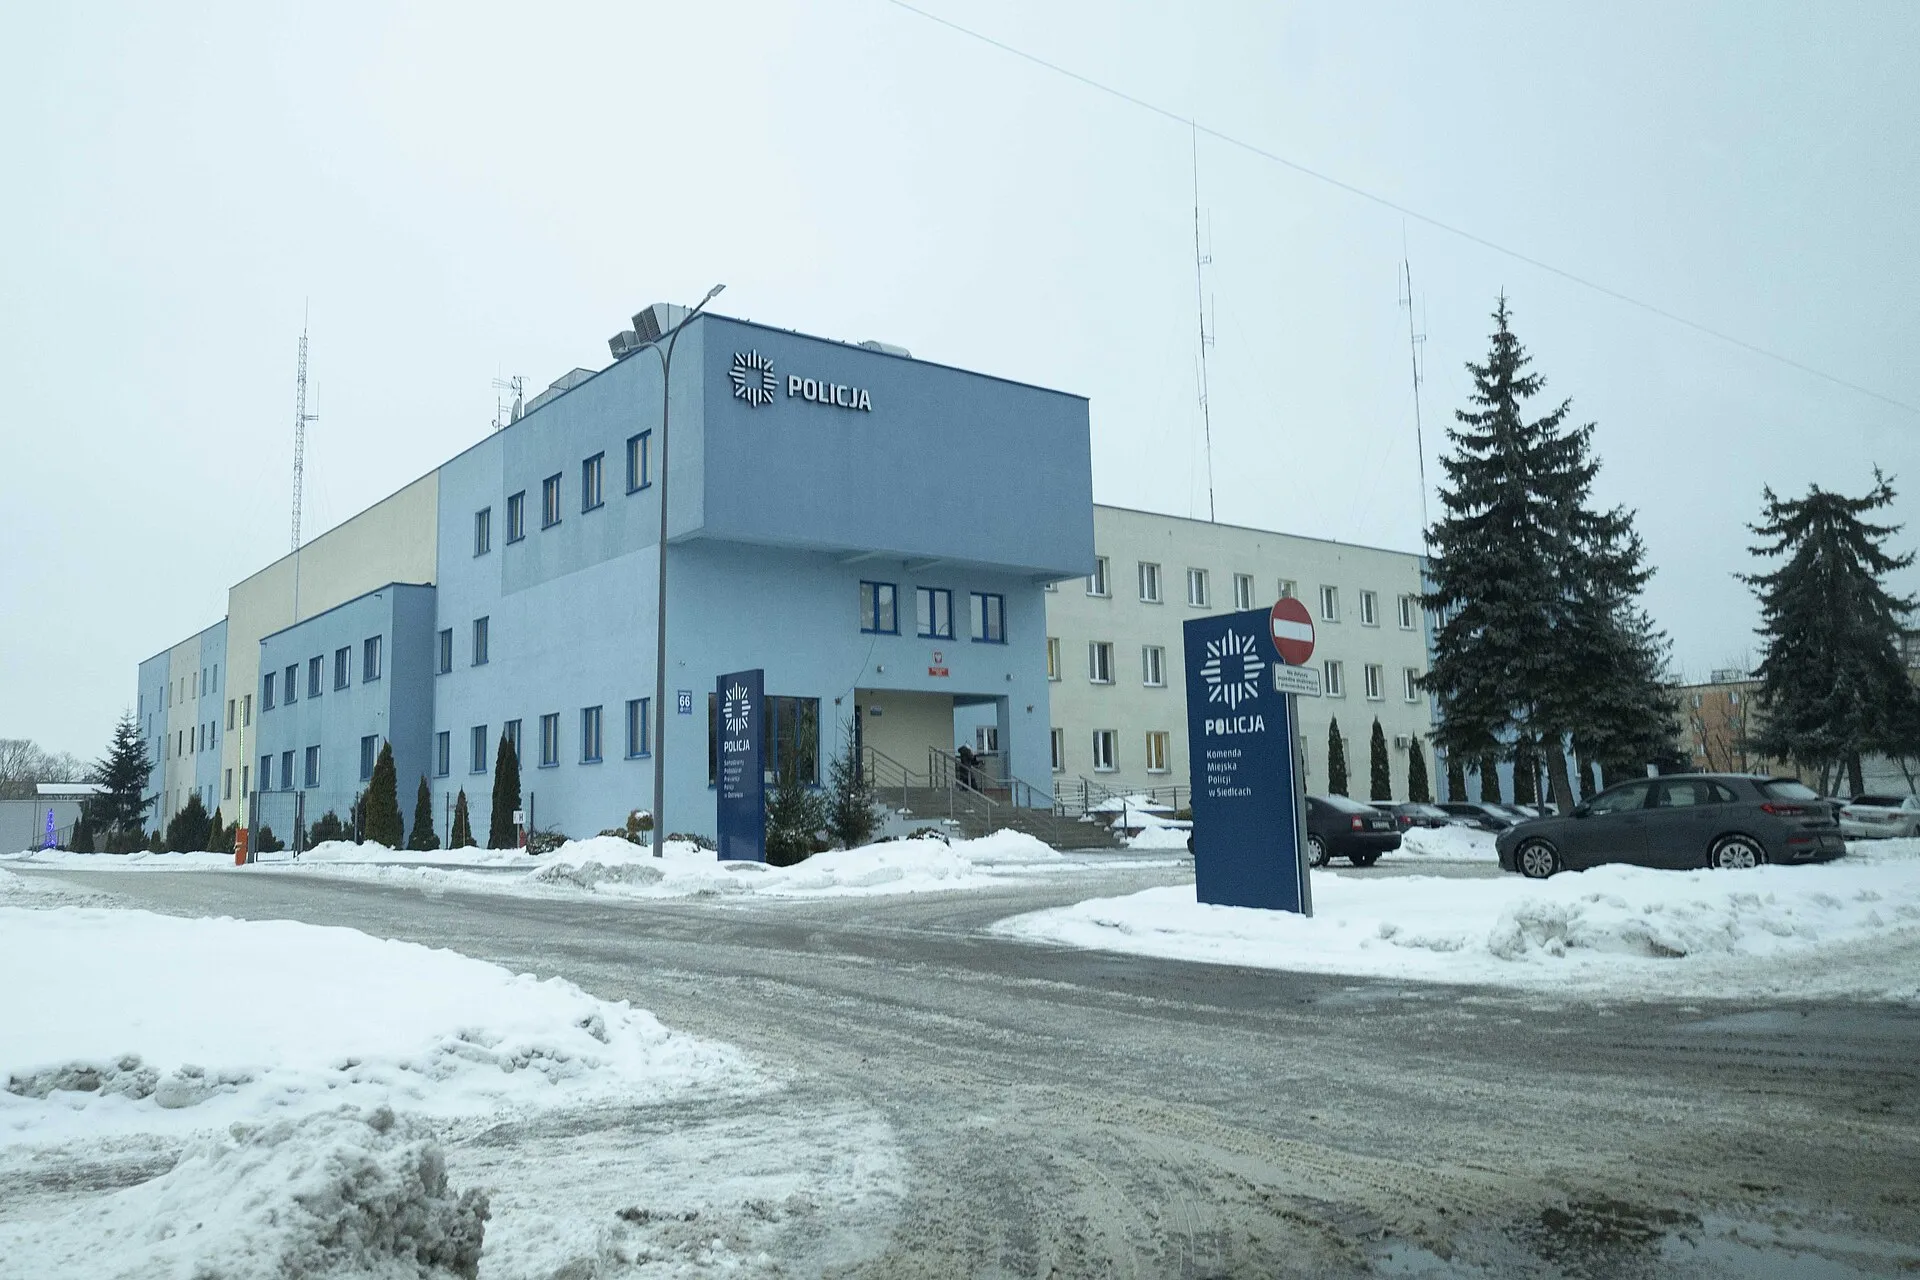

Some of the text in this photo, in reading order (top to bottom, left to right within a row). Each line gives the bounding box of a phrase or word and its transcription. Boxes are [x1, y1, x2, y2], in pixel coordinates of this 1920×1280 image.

[788, 374, 872, 411] POLICJA
[680, 695, 690, 707] 66
[1205, 715, 1265, 735] POLICJA
[724, 739, 750, 752] POLICJA
[1206, 749, 1241, 759] Komenda
[1207, 761, 1237, 773] Miejska
[1208, 775, 1231, 786] Policji
[1217, 787, 1251, 797] Siedlcach
